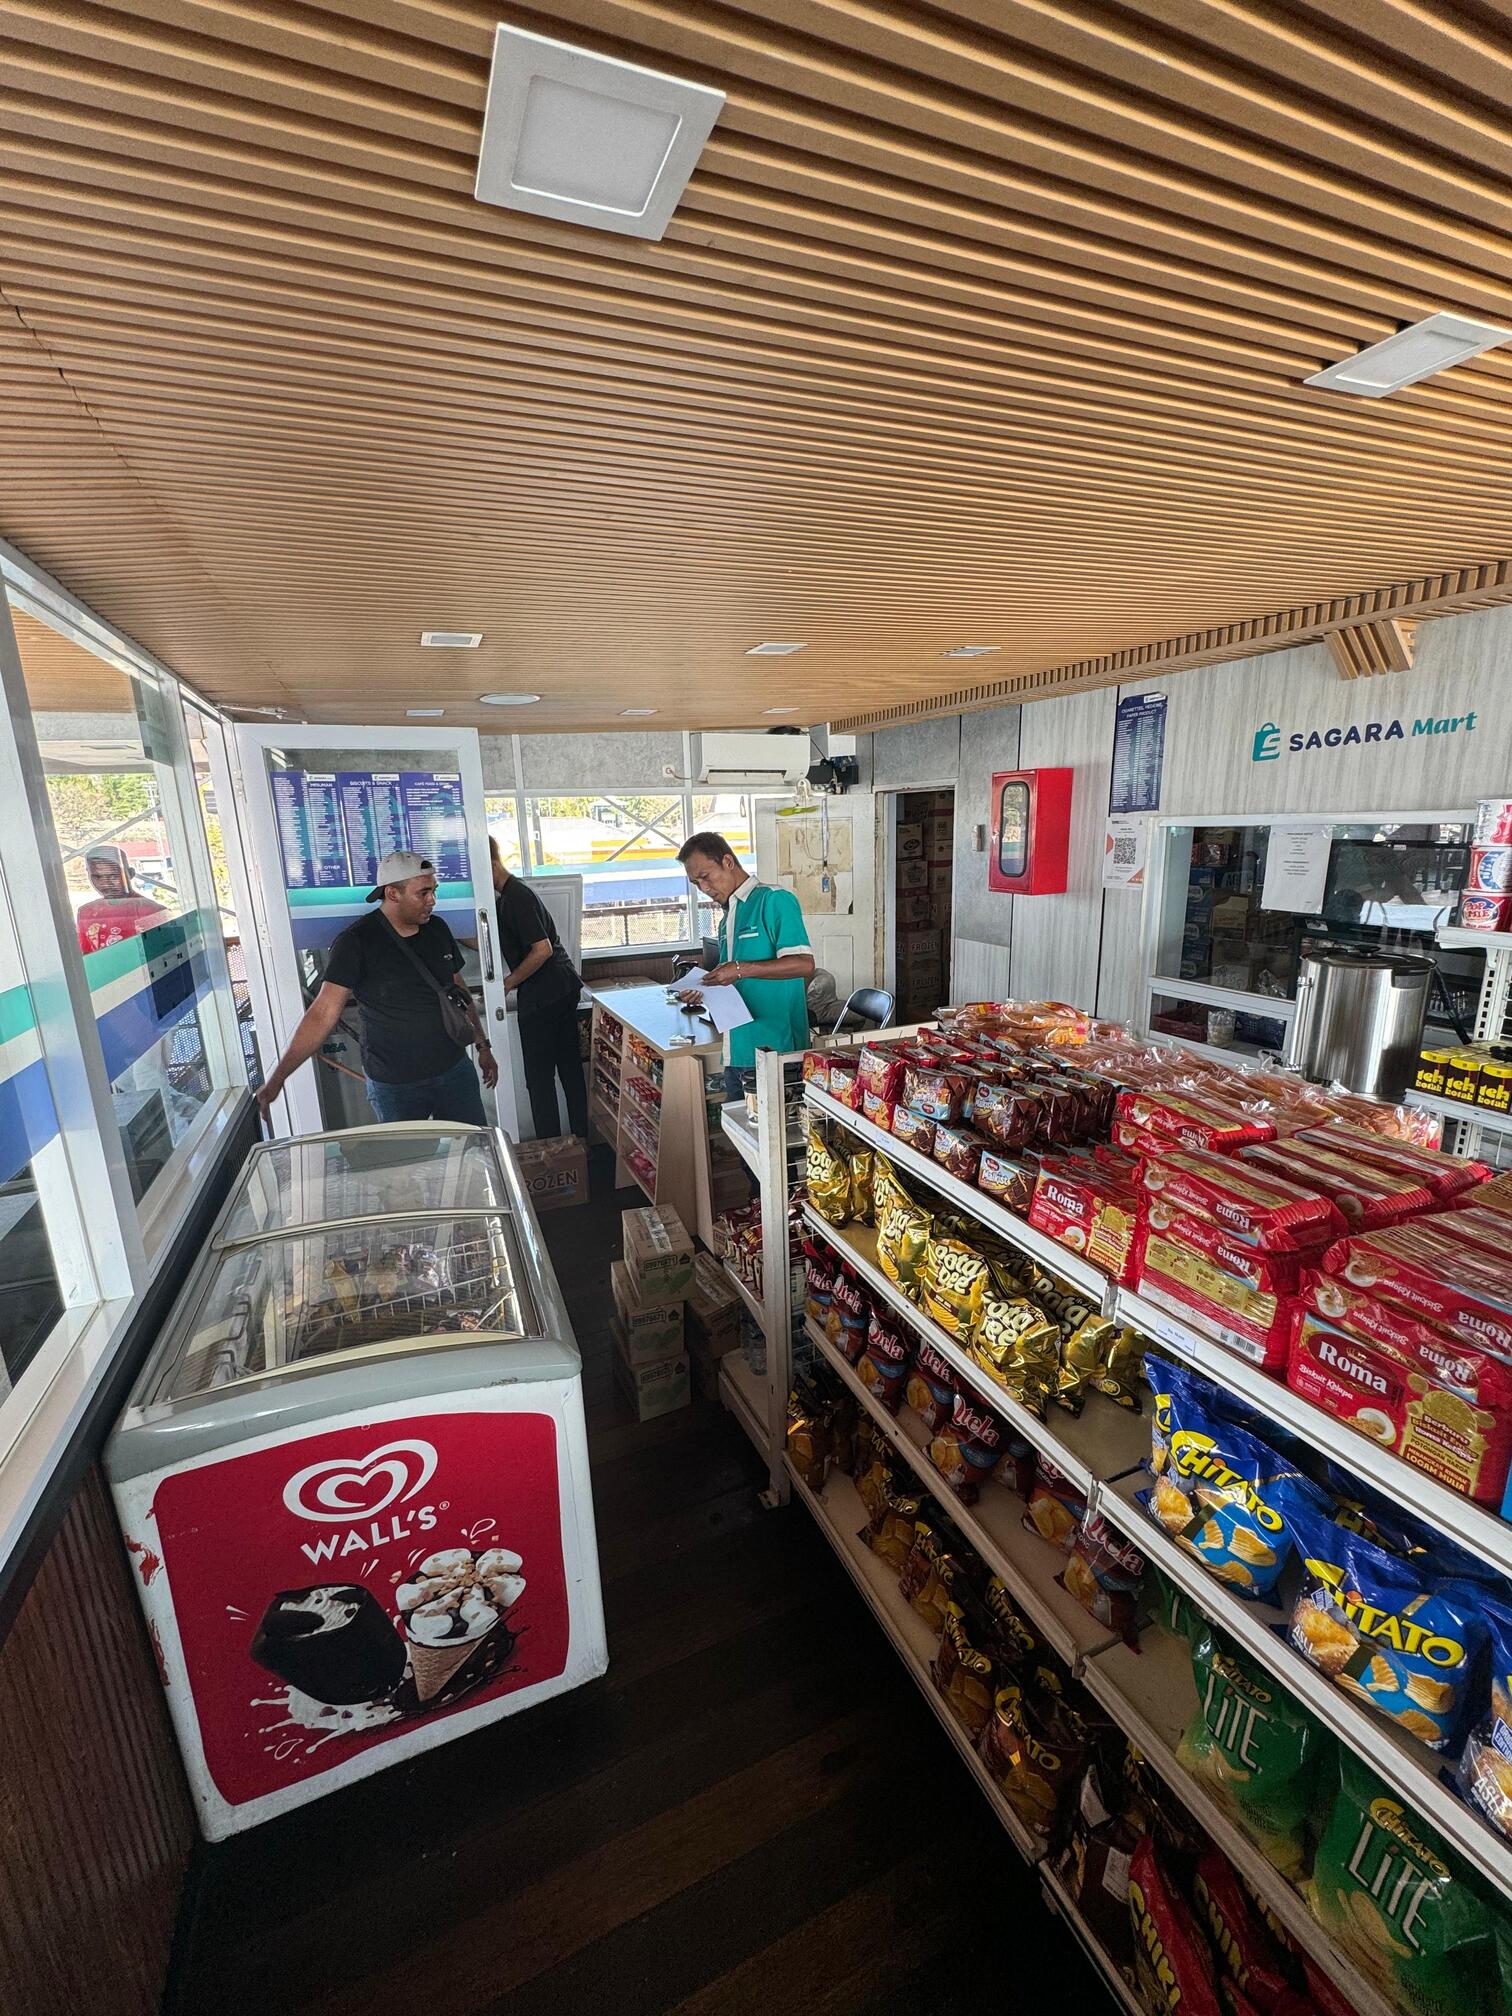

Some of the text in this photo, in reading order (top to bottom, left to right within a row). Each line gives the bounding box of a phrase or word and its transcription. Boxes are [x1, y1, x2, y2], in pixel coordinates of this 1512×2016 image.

[1289, 711, 1478, 752] SAGARA Mart
[1417, 1069, 1444, 1085] teh
[1447, 1077, 1476, 1093] teh
[1479, 1085, 1510, 1102] teh
[524, 1168, 578, 1193] ROZEN
[1046, 1184, 1084, 1214] Roma
[1215, 1203, 1250, 1230] Roma
[1216, 1245, 1251, 1273] Roma
[1353, 1310, 1409, 1346] Biskuit Kelapa
[1458, 1310, 1512, 1349] Roma
[1298, 1363, 1327, 1386] Biskuit
[1327, 1380, 1354, 1400] Kelapa
[1319, 1341, 1388, 1394] Roma
[1419, 1345, 1471, 1383] Roma
[952, 1393, 1000, 1447] Qtela
[1424, 1415, 1470, 1446] Berburu
[1406, 1453, 1466, 1492] LOGAM MULIA
[300, 1505, 438, 1566] WALL'S
[1474, 1776, 1507, 1816] ASLI
